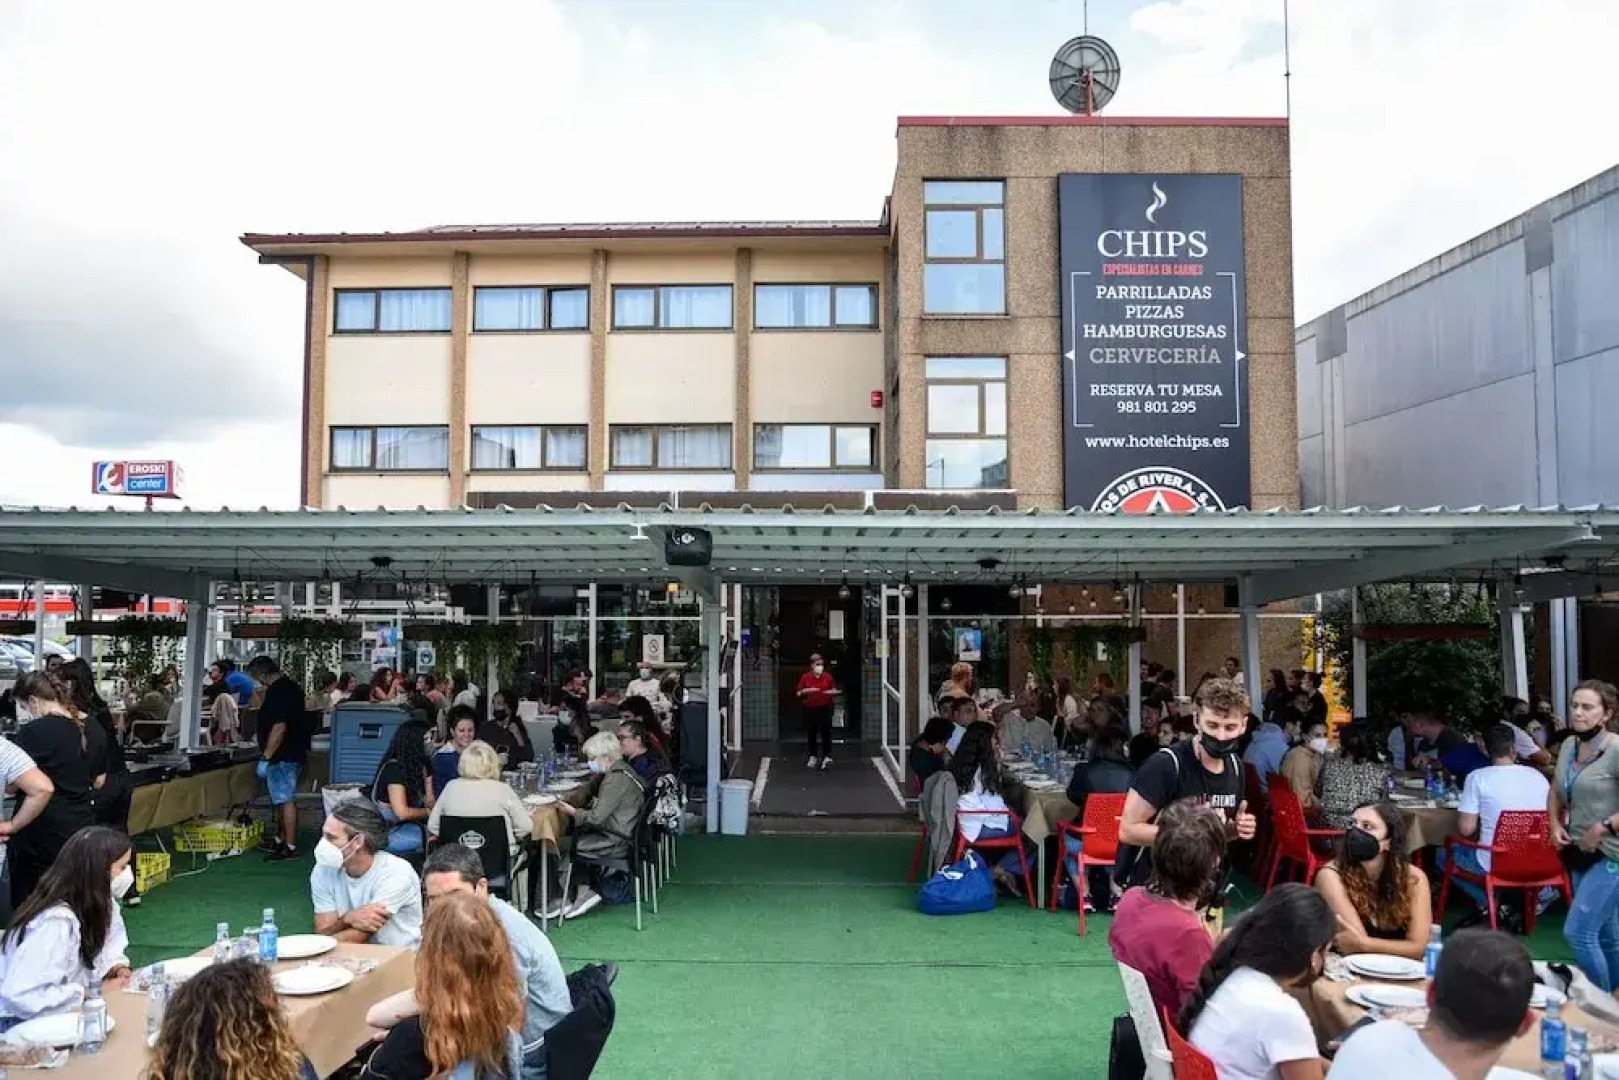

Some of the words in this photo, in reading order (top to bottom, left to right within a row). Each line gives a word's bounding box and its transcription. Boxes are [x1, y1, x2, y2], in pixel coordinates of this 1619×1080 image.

[1096, 229, 1209, 258] CHIPS
[1096, 285, 1212, 300] PARRILLADAS
[1125, 305, 1185, 320] PIZZAS
[1083, 324, 1227, 339] HAMBURGUESAS
[1089, 345, 1222, 364] CERVECERÍA
[1090, 384, 1155, 397] RESERVA
[1158, 384, 1179, 396] TU
[1182, 384, 1223, 397] MESA
[1117, 401, 1142, 414] 981
[1145, 401, 1169, 414] 801
[1171, 401, 1197, 414] 295
[1085, 434, 1230, 450] www.hotelchips.es
[129, 464, 165, 474] EROSKI
[130, 478, 162, 488] center
[1117, 479, 1138, 495] DE
